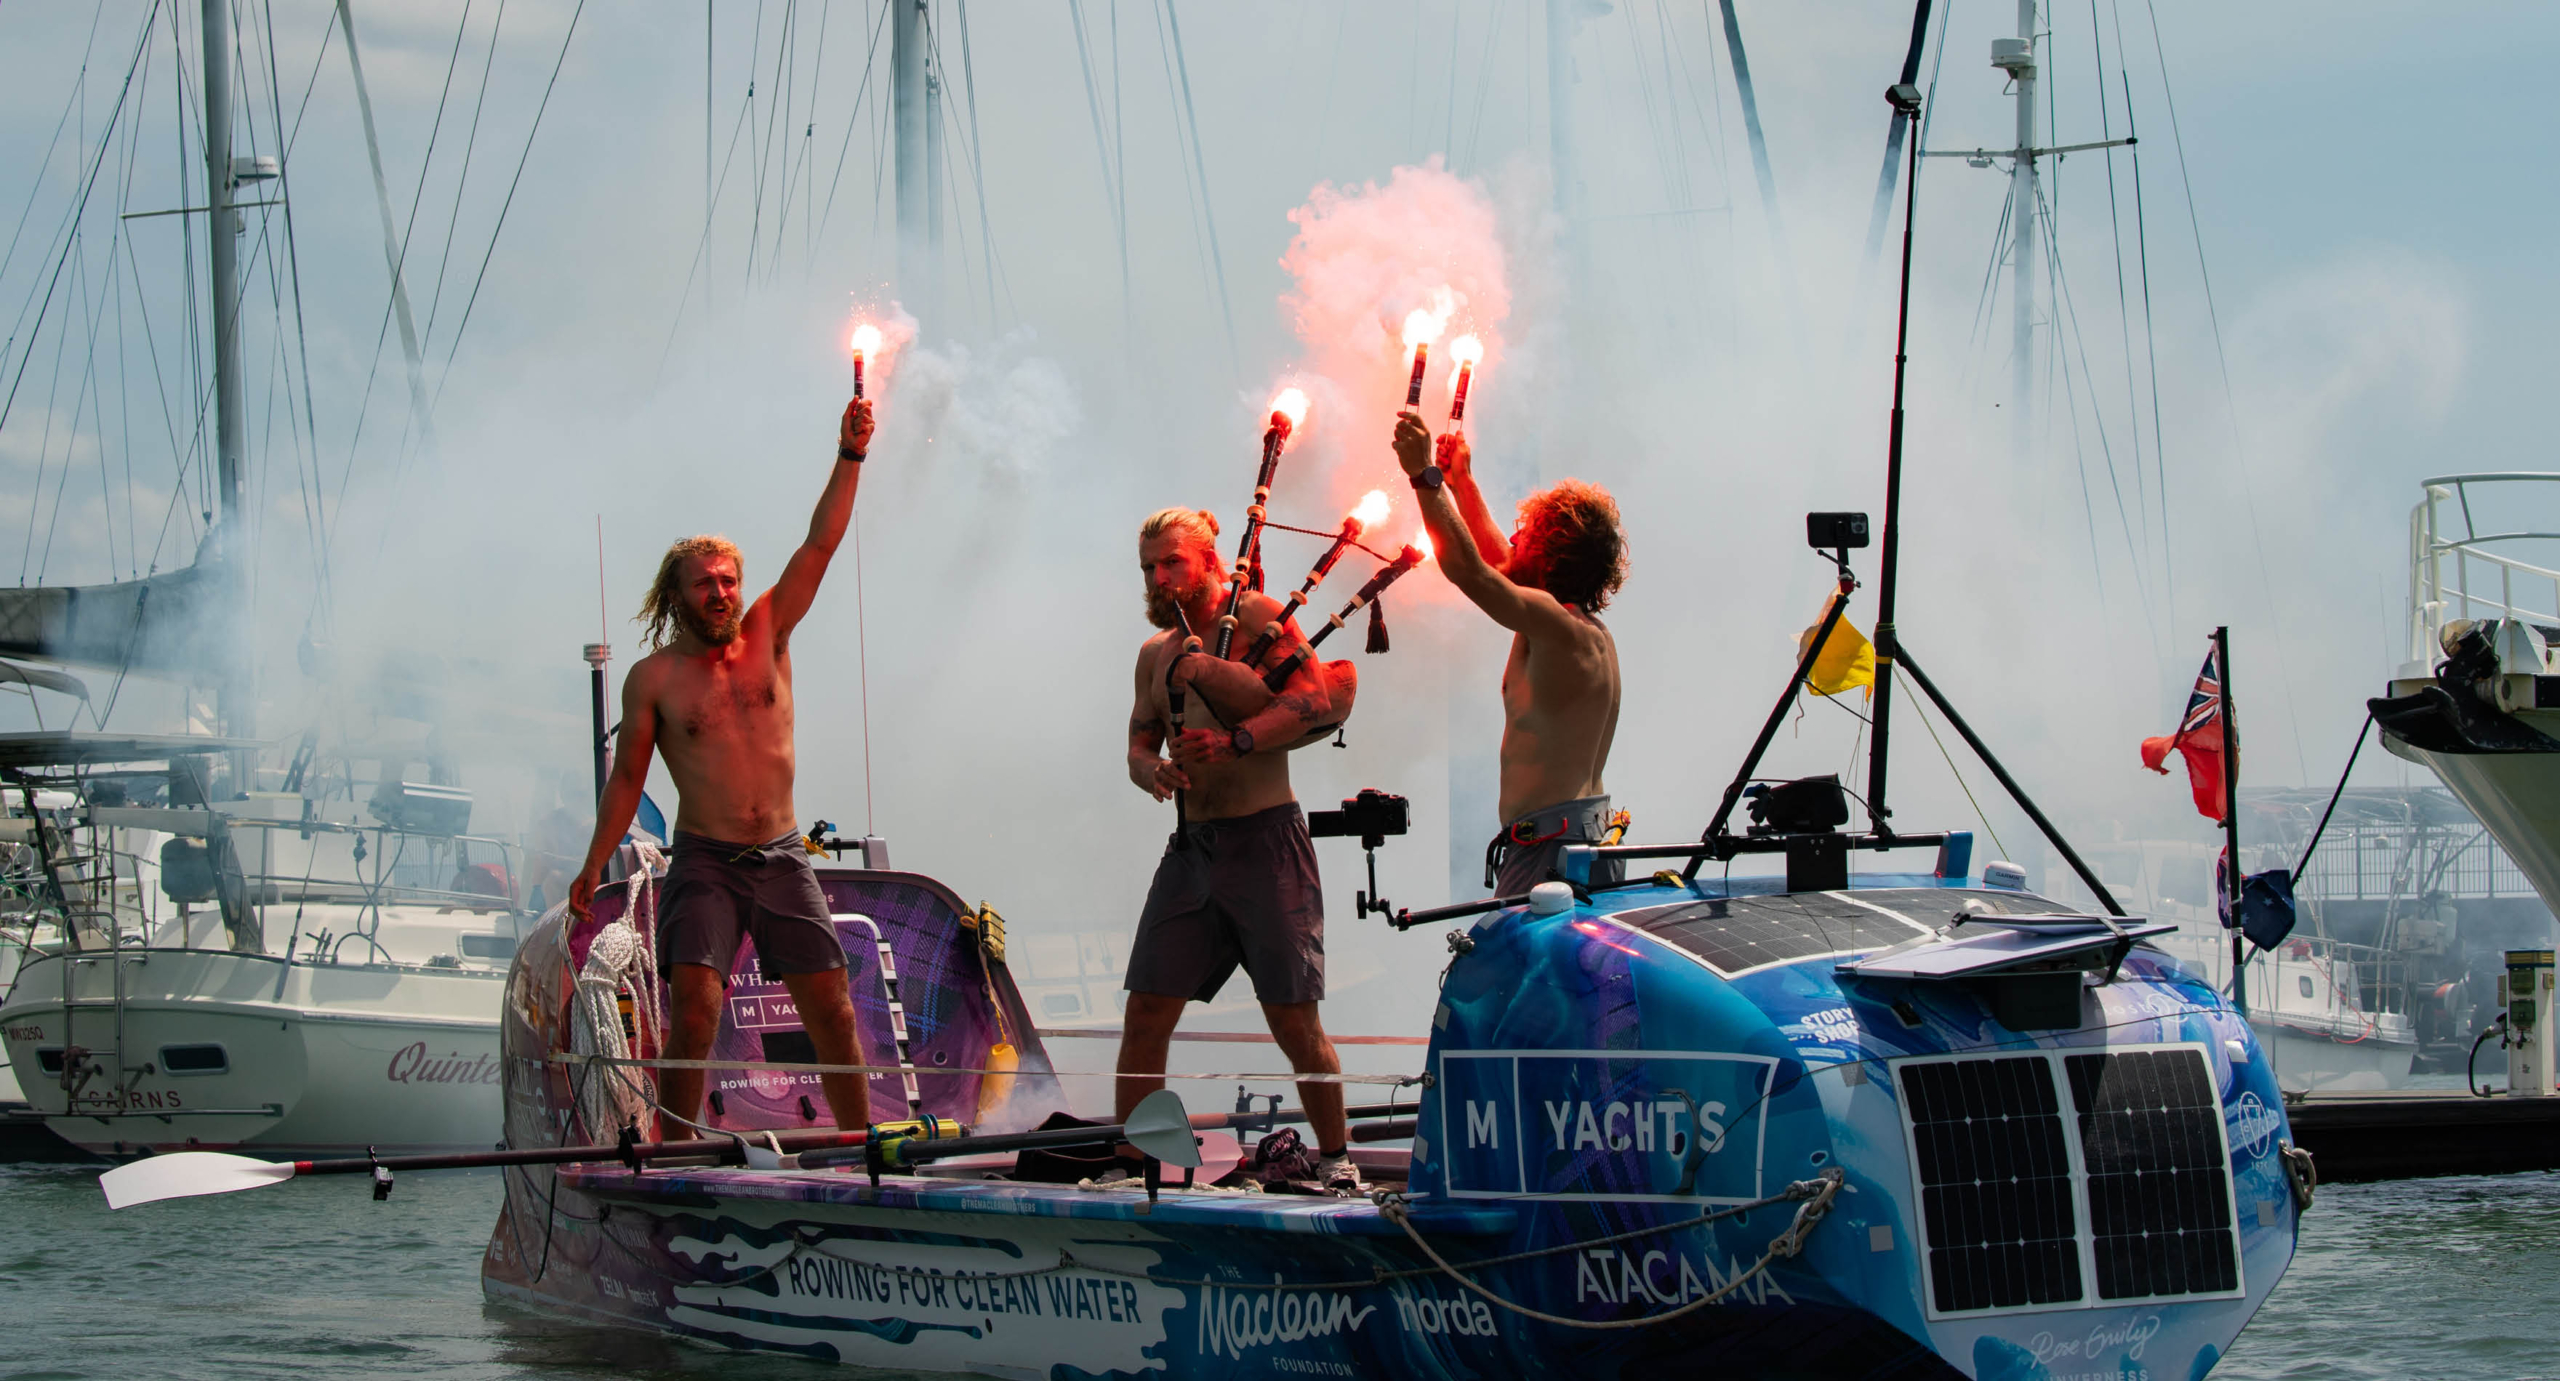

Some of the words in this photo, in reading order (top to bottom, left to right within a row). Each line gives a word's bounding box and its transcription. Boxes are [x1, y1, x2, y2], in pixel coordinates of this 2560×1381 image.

[741, 1005, 756, 1018] M
[771, 1003, 799, 1016] YAC
[1801, 1007, 1855, 1030] STORY
[1815, 1020, 1860, 1043] SHOP
[387, 1040, 500, 1085] Quinte
[720, 1077, 770, 1090] ROWING
[773, 1075, 797, 1087] FOR
[800, 1073, 822, 1085] CLE
[1465, 1099, 1499, 1150] M
[1544, 1100, 1727, 1153] YACHTS
[787, 1256, 891, 1304] ROWING
[895, 1265, 950, 1309] FOR
[954, 1269, 1042, 1316] CLEAN
[1044, 1273, 1142, 1324] WATER
[1217, 1264, 1243, 1280] THE
[1576, 1249, 1797, 1306] ATACAMA
[1199, 1272, 1378, 1361] Maclean
[1388, 1287, 1498, 1336] norda
[2031, 1331, 2079, 1370] Rose
[2085, 1315, 2161, 1361] Emily
[1272, 1355, 1354, 1378] FOUNDATION
